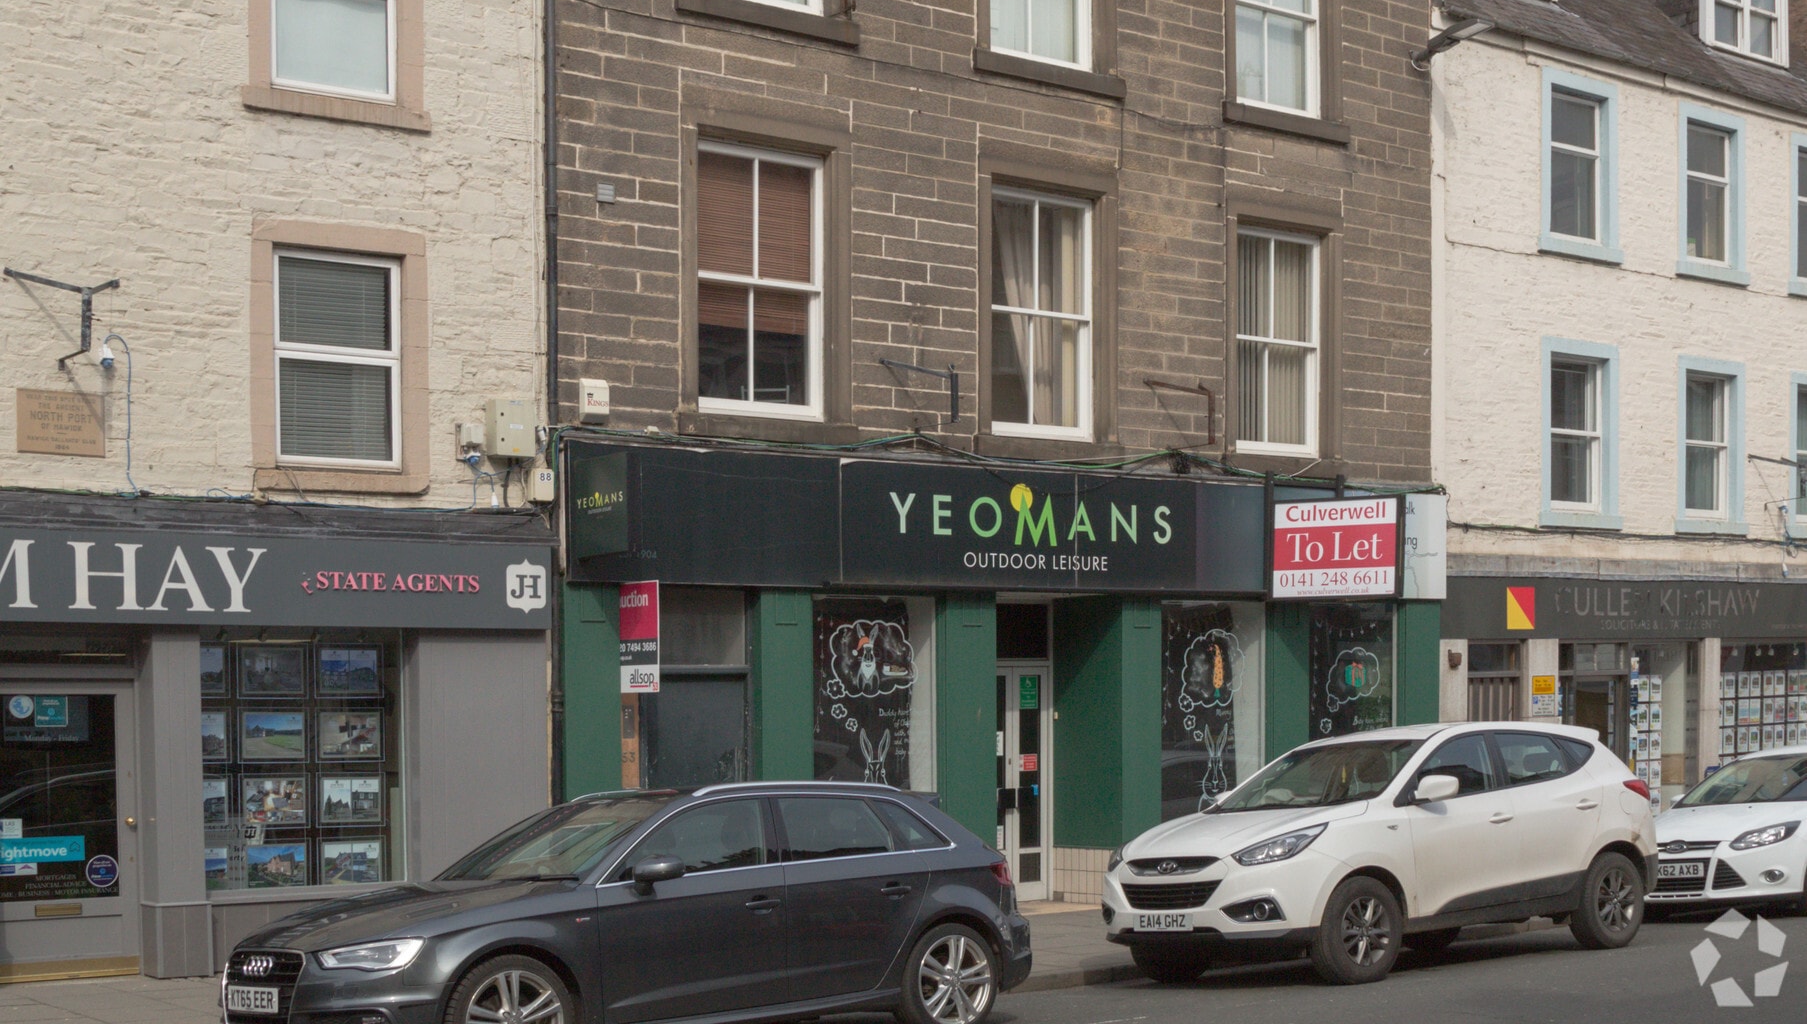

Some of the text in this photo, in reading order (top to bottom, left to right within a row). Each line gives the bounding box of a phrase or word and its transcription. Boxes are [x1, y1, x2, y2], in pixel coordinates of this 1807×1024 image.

[587, 398, 609, 408] KINGS
[30, 410, 93, 424] NORTH PORT
[539, 472, 552, 482] 88
[577, 491, 624, 510] YEOMANS
[889, 492, 1172, 548] YEOMANS
[1285, 501, 1386, 523] Culverwell
[1286, 531, 1383, 563] To Let
[963, 551, 1108, 572] OUTDOOR LEISURE
[66, 541, 268, 612] HAY
[391, 573, 481, 594] AGENTS
[1279, 570, 1388, 588] 0141 248 6611
[1659, 588, 1760, 617] KISHAW
[629, 668, 655, 687] allsop
[0, 845, 68, 862] ightmove
[1678, 863, 1699, 877] AXB
[1140, 913, 1187, 929] EA14 GHZ
[231, 988, 274, 1010] KT65 EER
